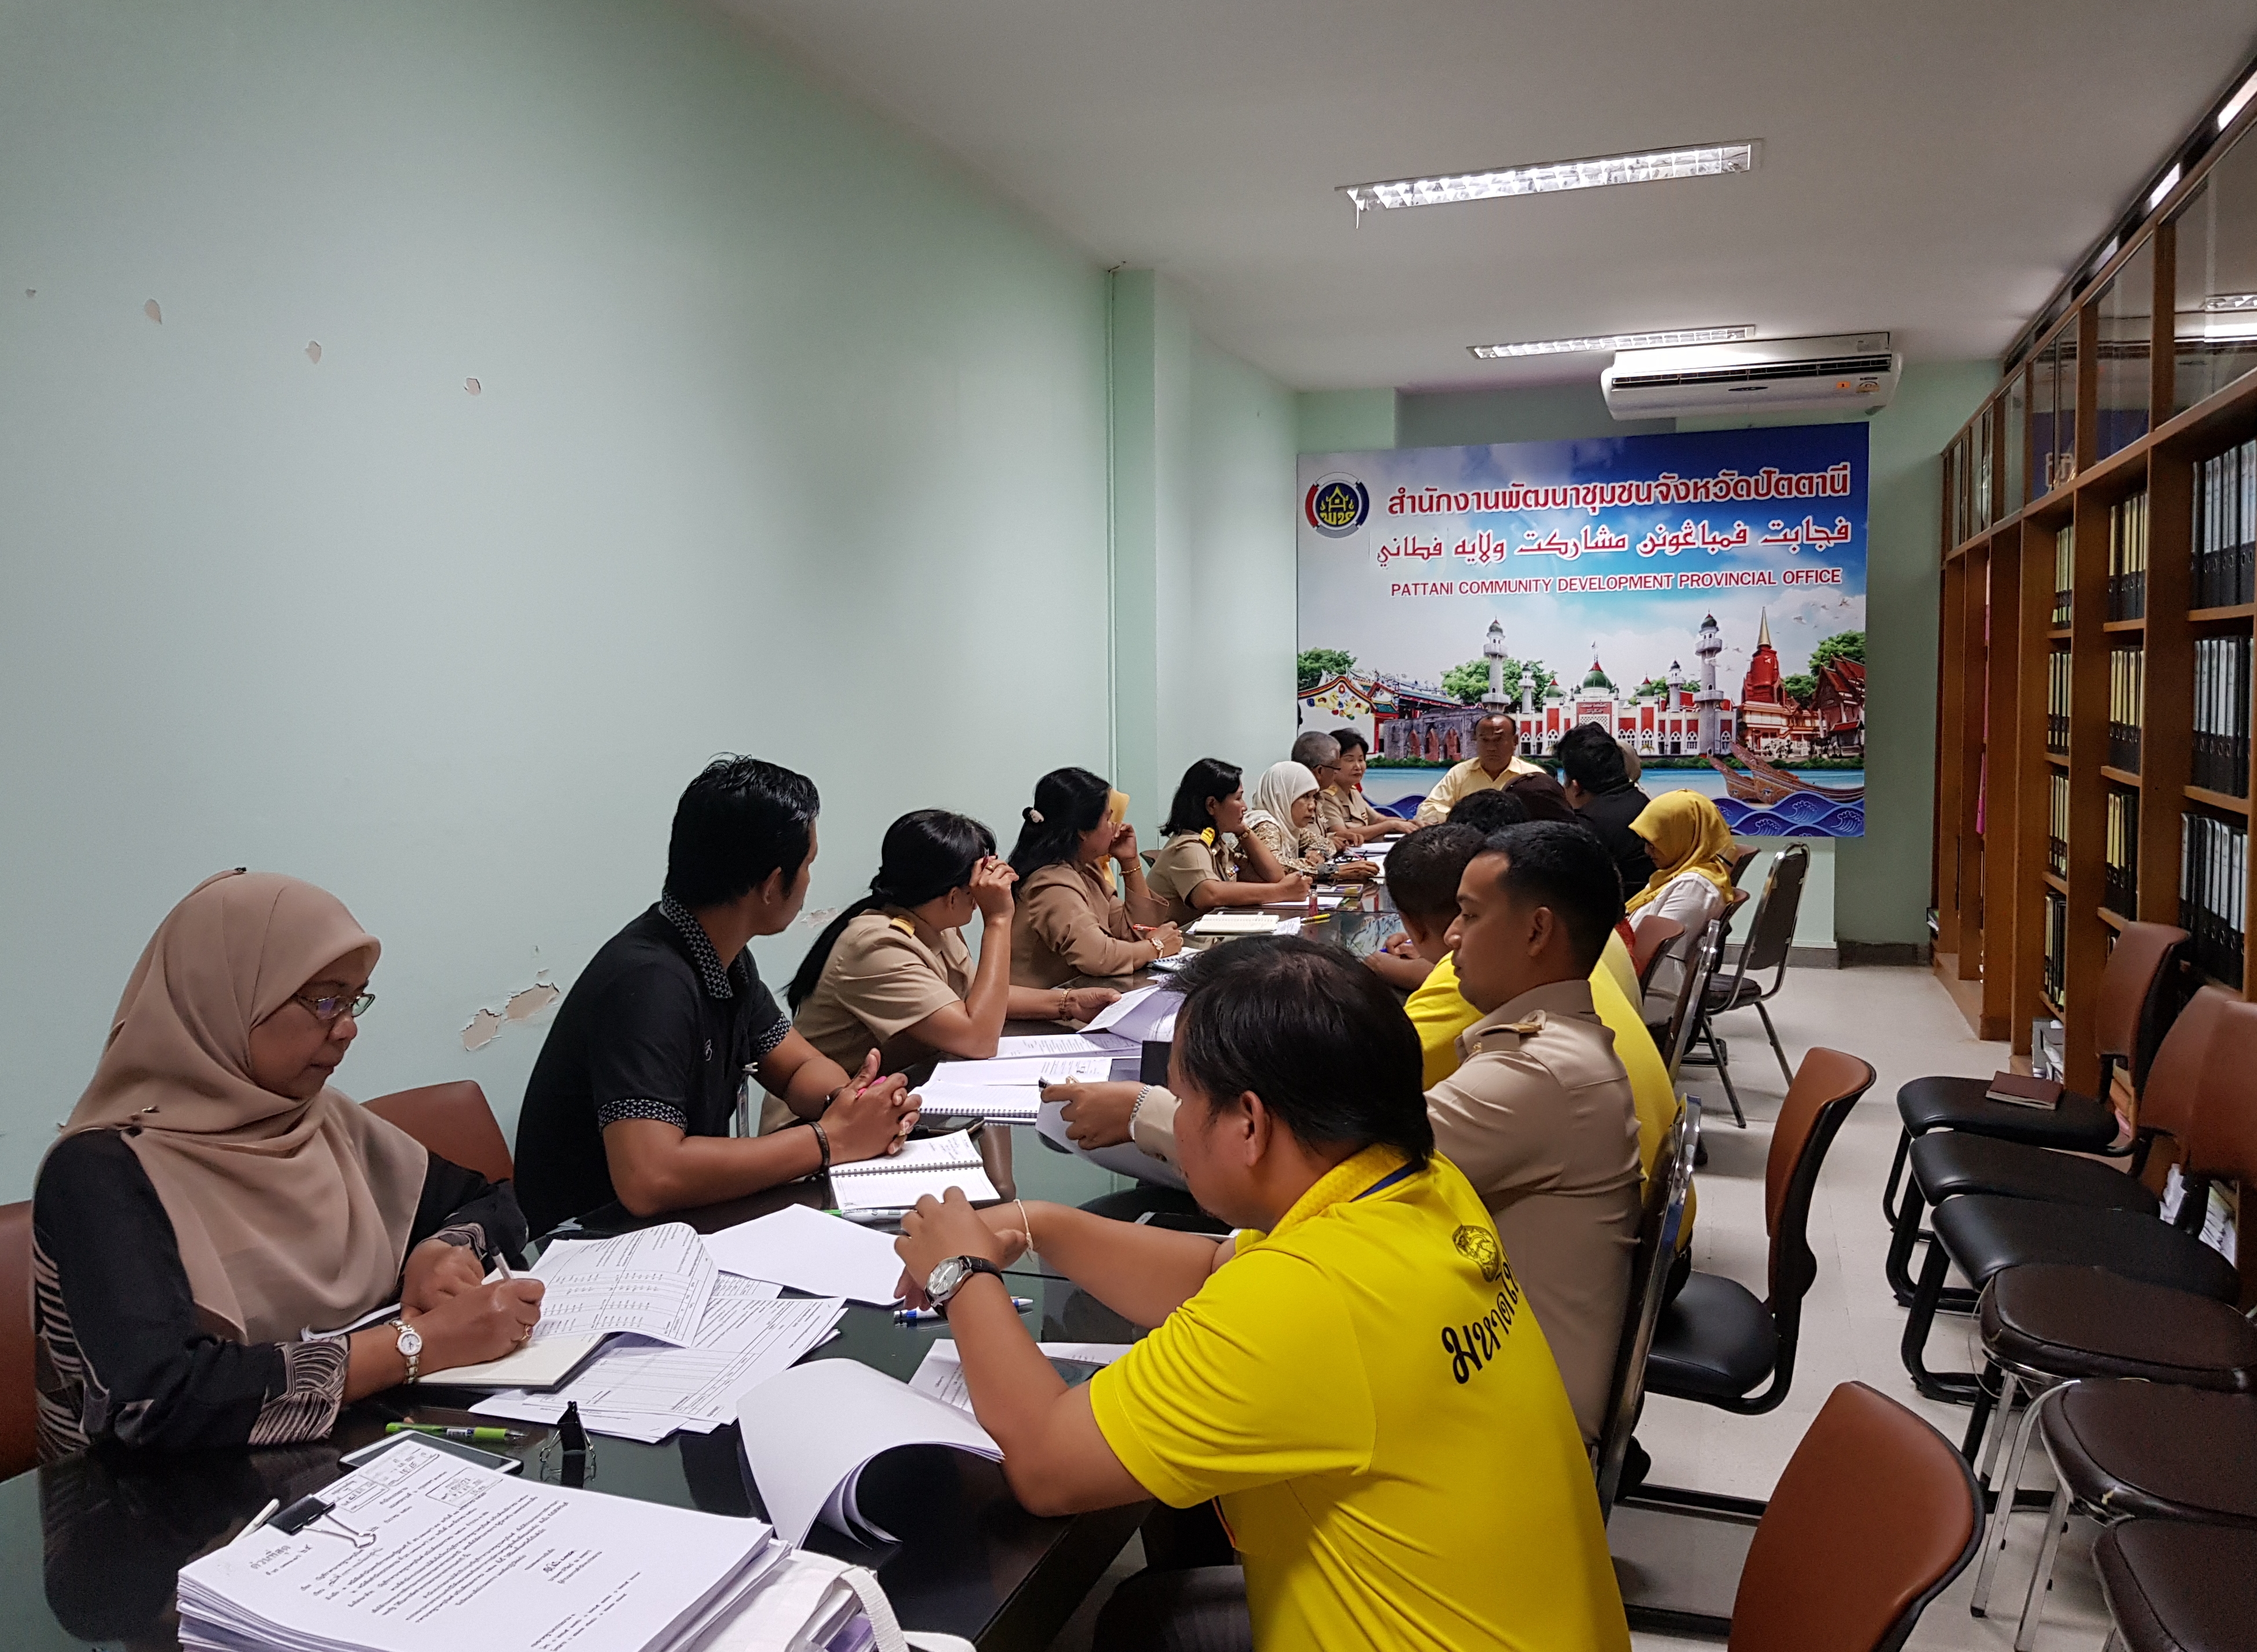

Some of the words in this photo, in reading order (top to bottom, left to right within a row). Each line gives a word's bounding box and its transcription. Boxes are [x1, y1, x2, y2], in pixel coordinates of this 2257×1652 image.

[1388, 464, 1848, 513] สำนักงานพัฒนาชุมชนจังหวัดปัตตานี
[1377, 535, 1443, 567] فطاني
[1392, 582, 1453, 596] PATTANI
[1458, 578, 1552, 595] COMMUNITY
[1557, 574, 1673, 592] DEVELOPMENT
[1679, 571, 1777, 588] PROVINCIAL
[1783, 569, 1841, 584] OFFICE
